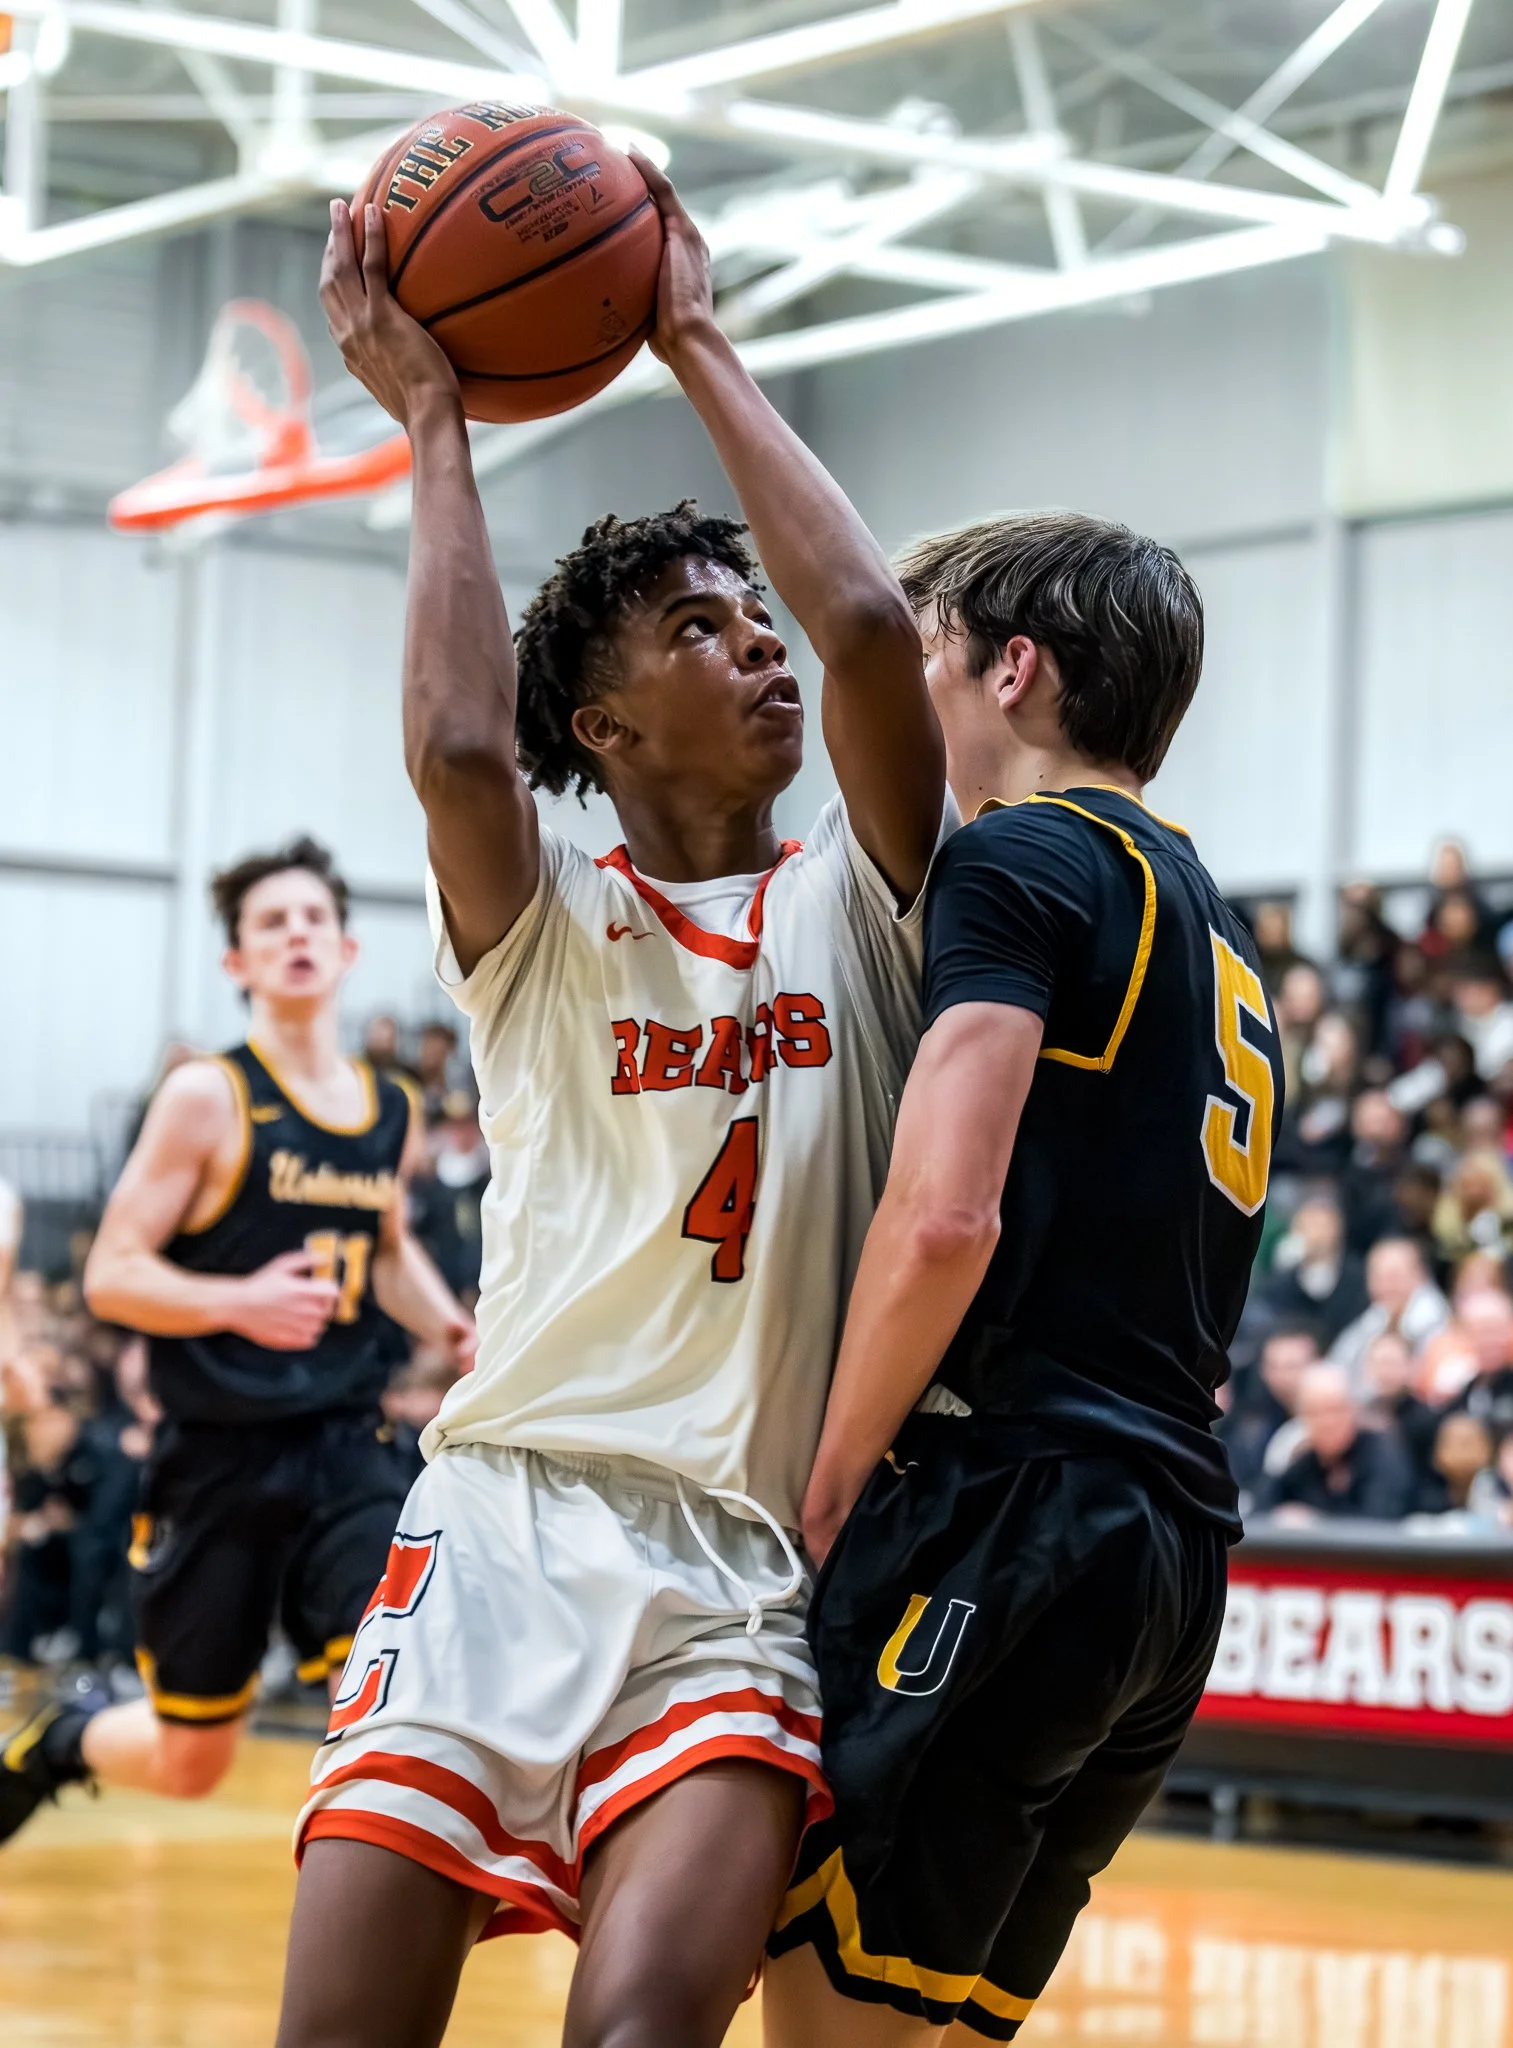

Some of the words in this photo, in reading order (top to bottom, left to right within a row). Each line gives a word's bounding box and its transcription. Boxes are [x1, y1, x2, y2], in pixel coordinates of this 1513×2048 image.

[382, 127, 475, 214] THE
[610, 991, 833, 1095] BEARS
[1200, 921, 1275, 1218] 5
[680, 1115, 759, 1284] 4
[877, 1593, 977, 1697] U
[1204, 1581, 1513, 1717] BEARS
